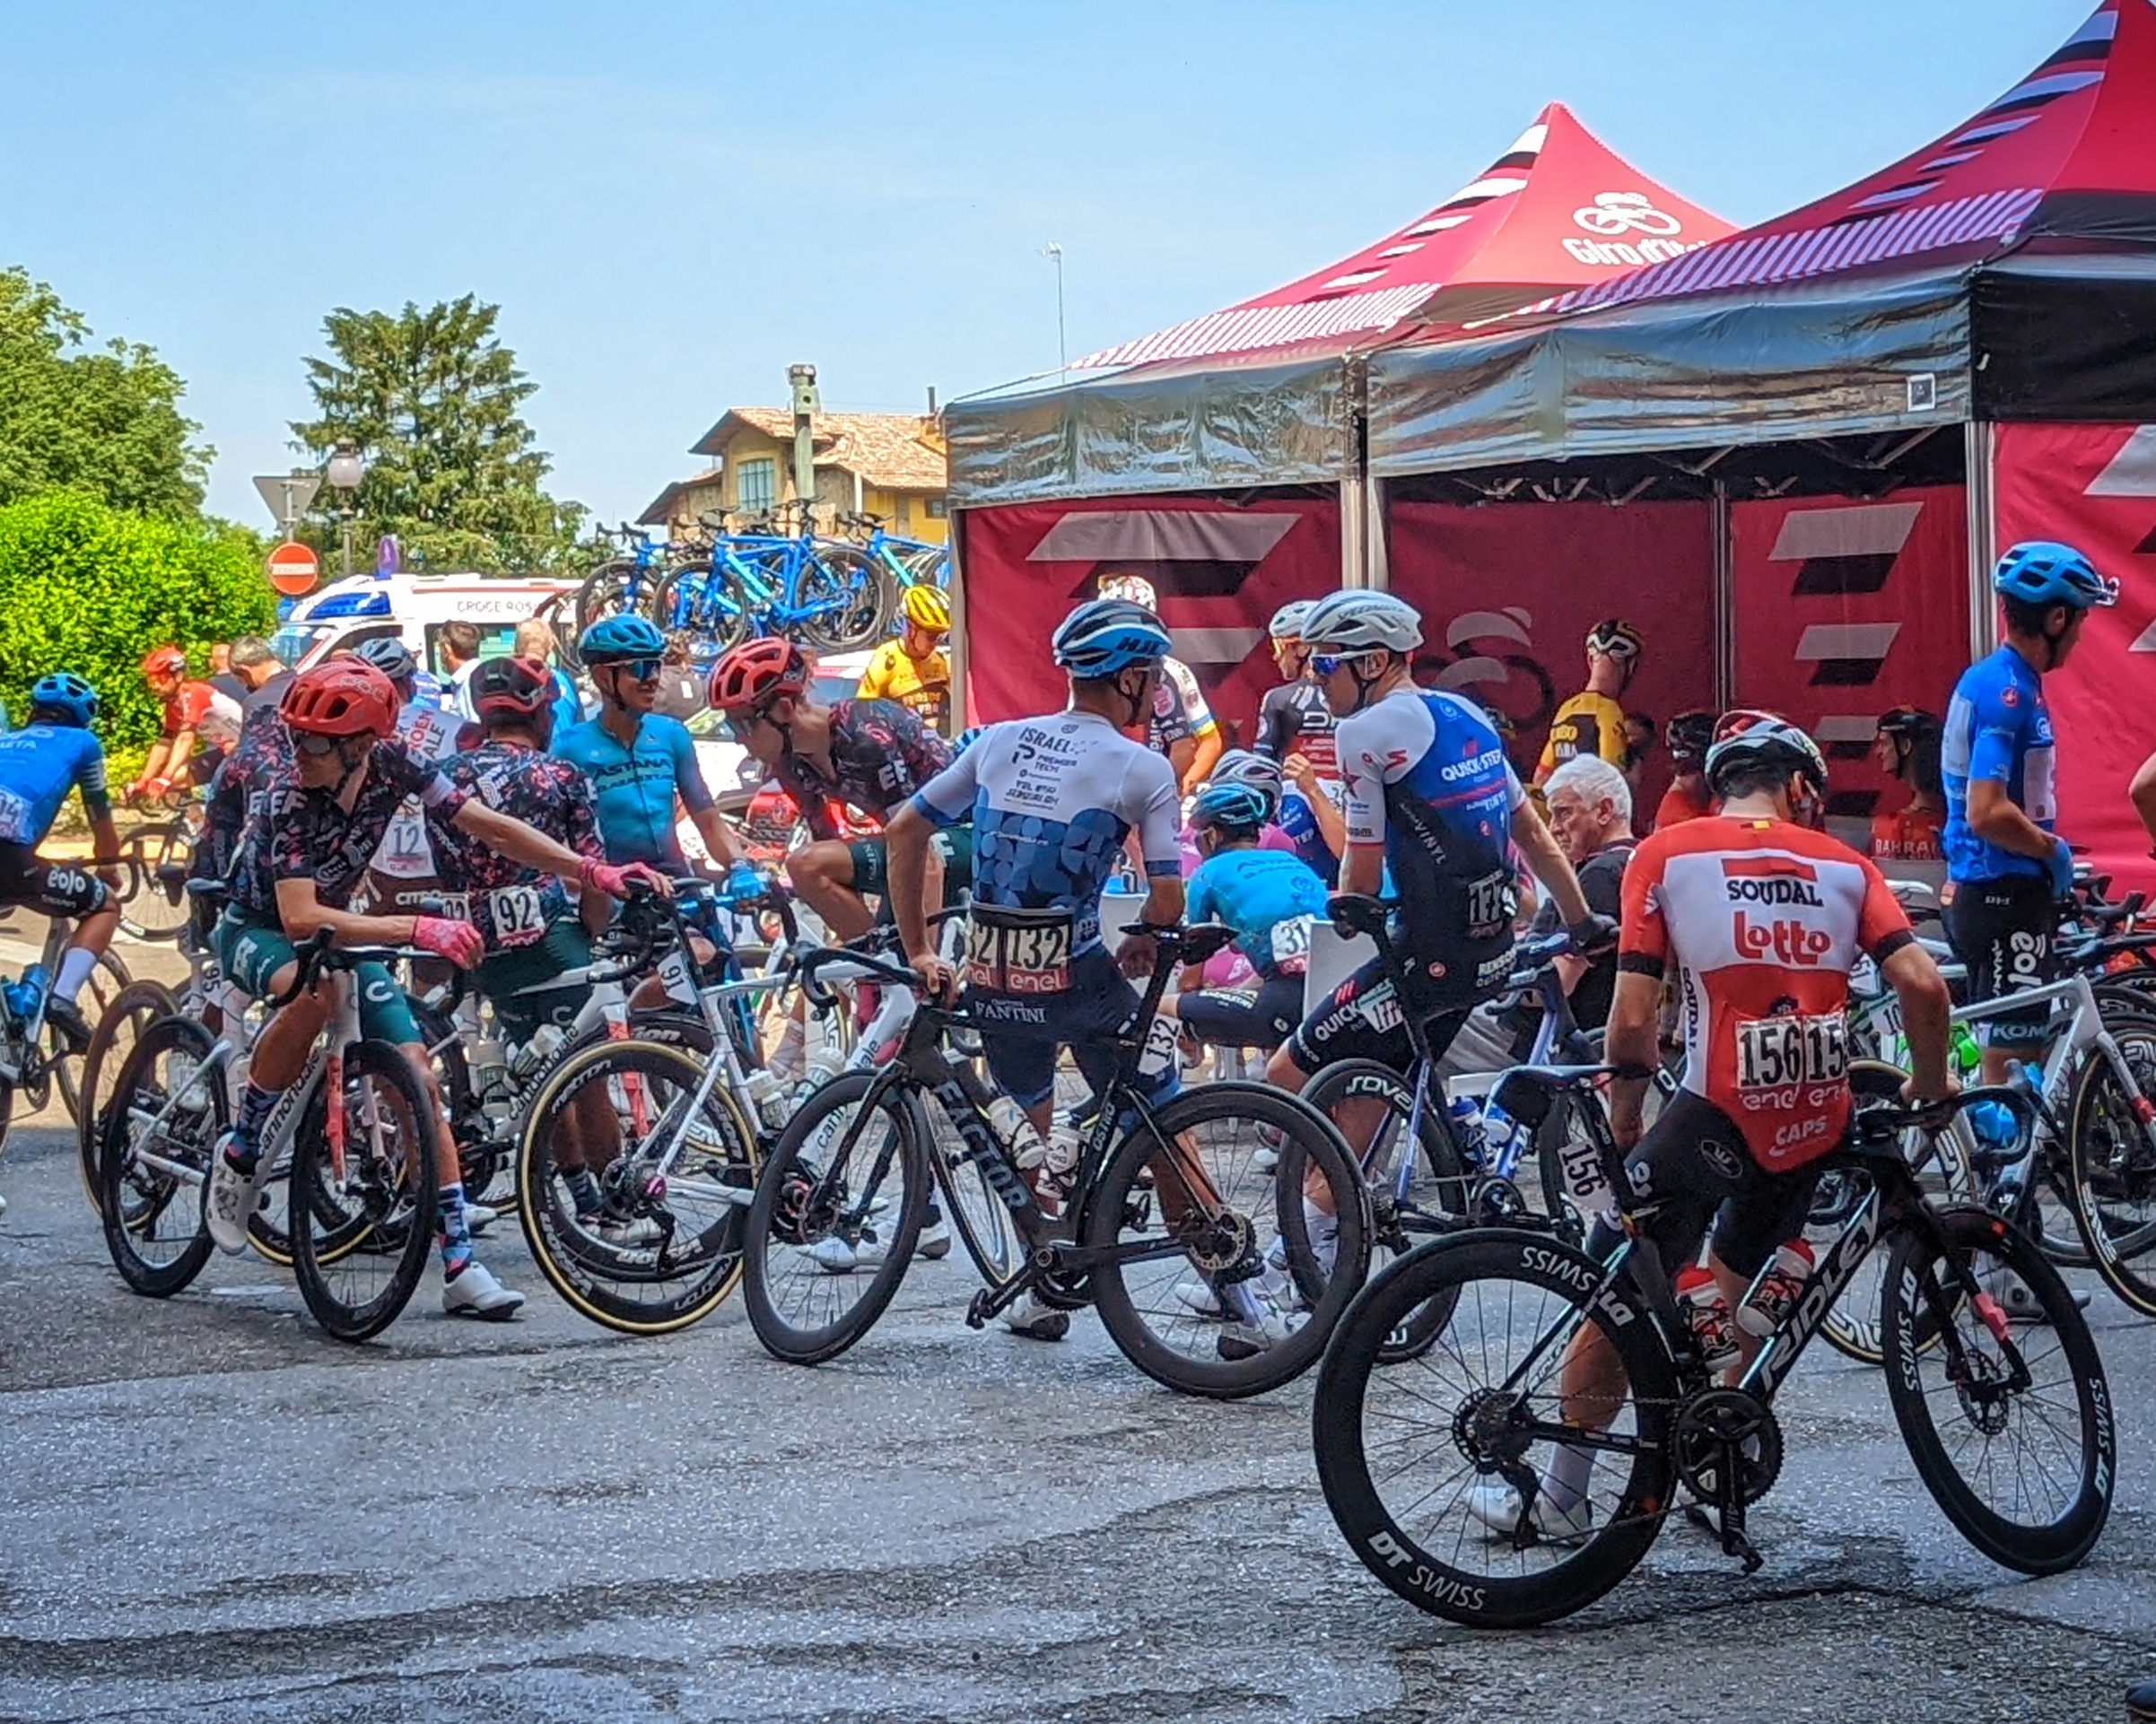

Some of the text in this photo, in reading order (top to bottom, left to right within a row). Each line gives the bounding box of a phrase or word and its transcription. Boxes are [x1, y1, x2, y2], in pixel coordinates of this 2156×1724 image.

[1562, 238, 1644, 265] Giro
[458, 601, 501, 613] CROCE
[1018, 727, 1071, 753] ISRAEL
[498, 892, 533, 933] 92
[1726, 879, 1824, 907] SOUDAL
[1008, 927, 1061, 971] 132
[2007, 929, 2044, 990] eol
[662, 965, 687, 995] 91
[1010, 971, 1067, 992] enel
[975, 1000, 1046, 1023] FANTINI
[1144, 1021, 1180, 1063] 132
[1738, 1023, 1801, 1087] 156
[934, 1079, 1032, 1209] FACTOR
[1775, 1115, 1828, 1145] CAPS
[1561, 1143, 1606, 1197] 156
[1520, 1246, 1602, 1293] SWISS
[1759, 1203, 1881, 1394] RIDLEY
[1897, 1309, 1920, 1394] SWISS
[2088, 1377, 2112, 1455] SWISS
[1366, 1529, 1487, 1612] DT SWISS
